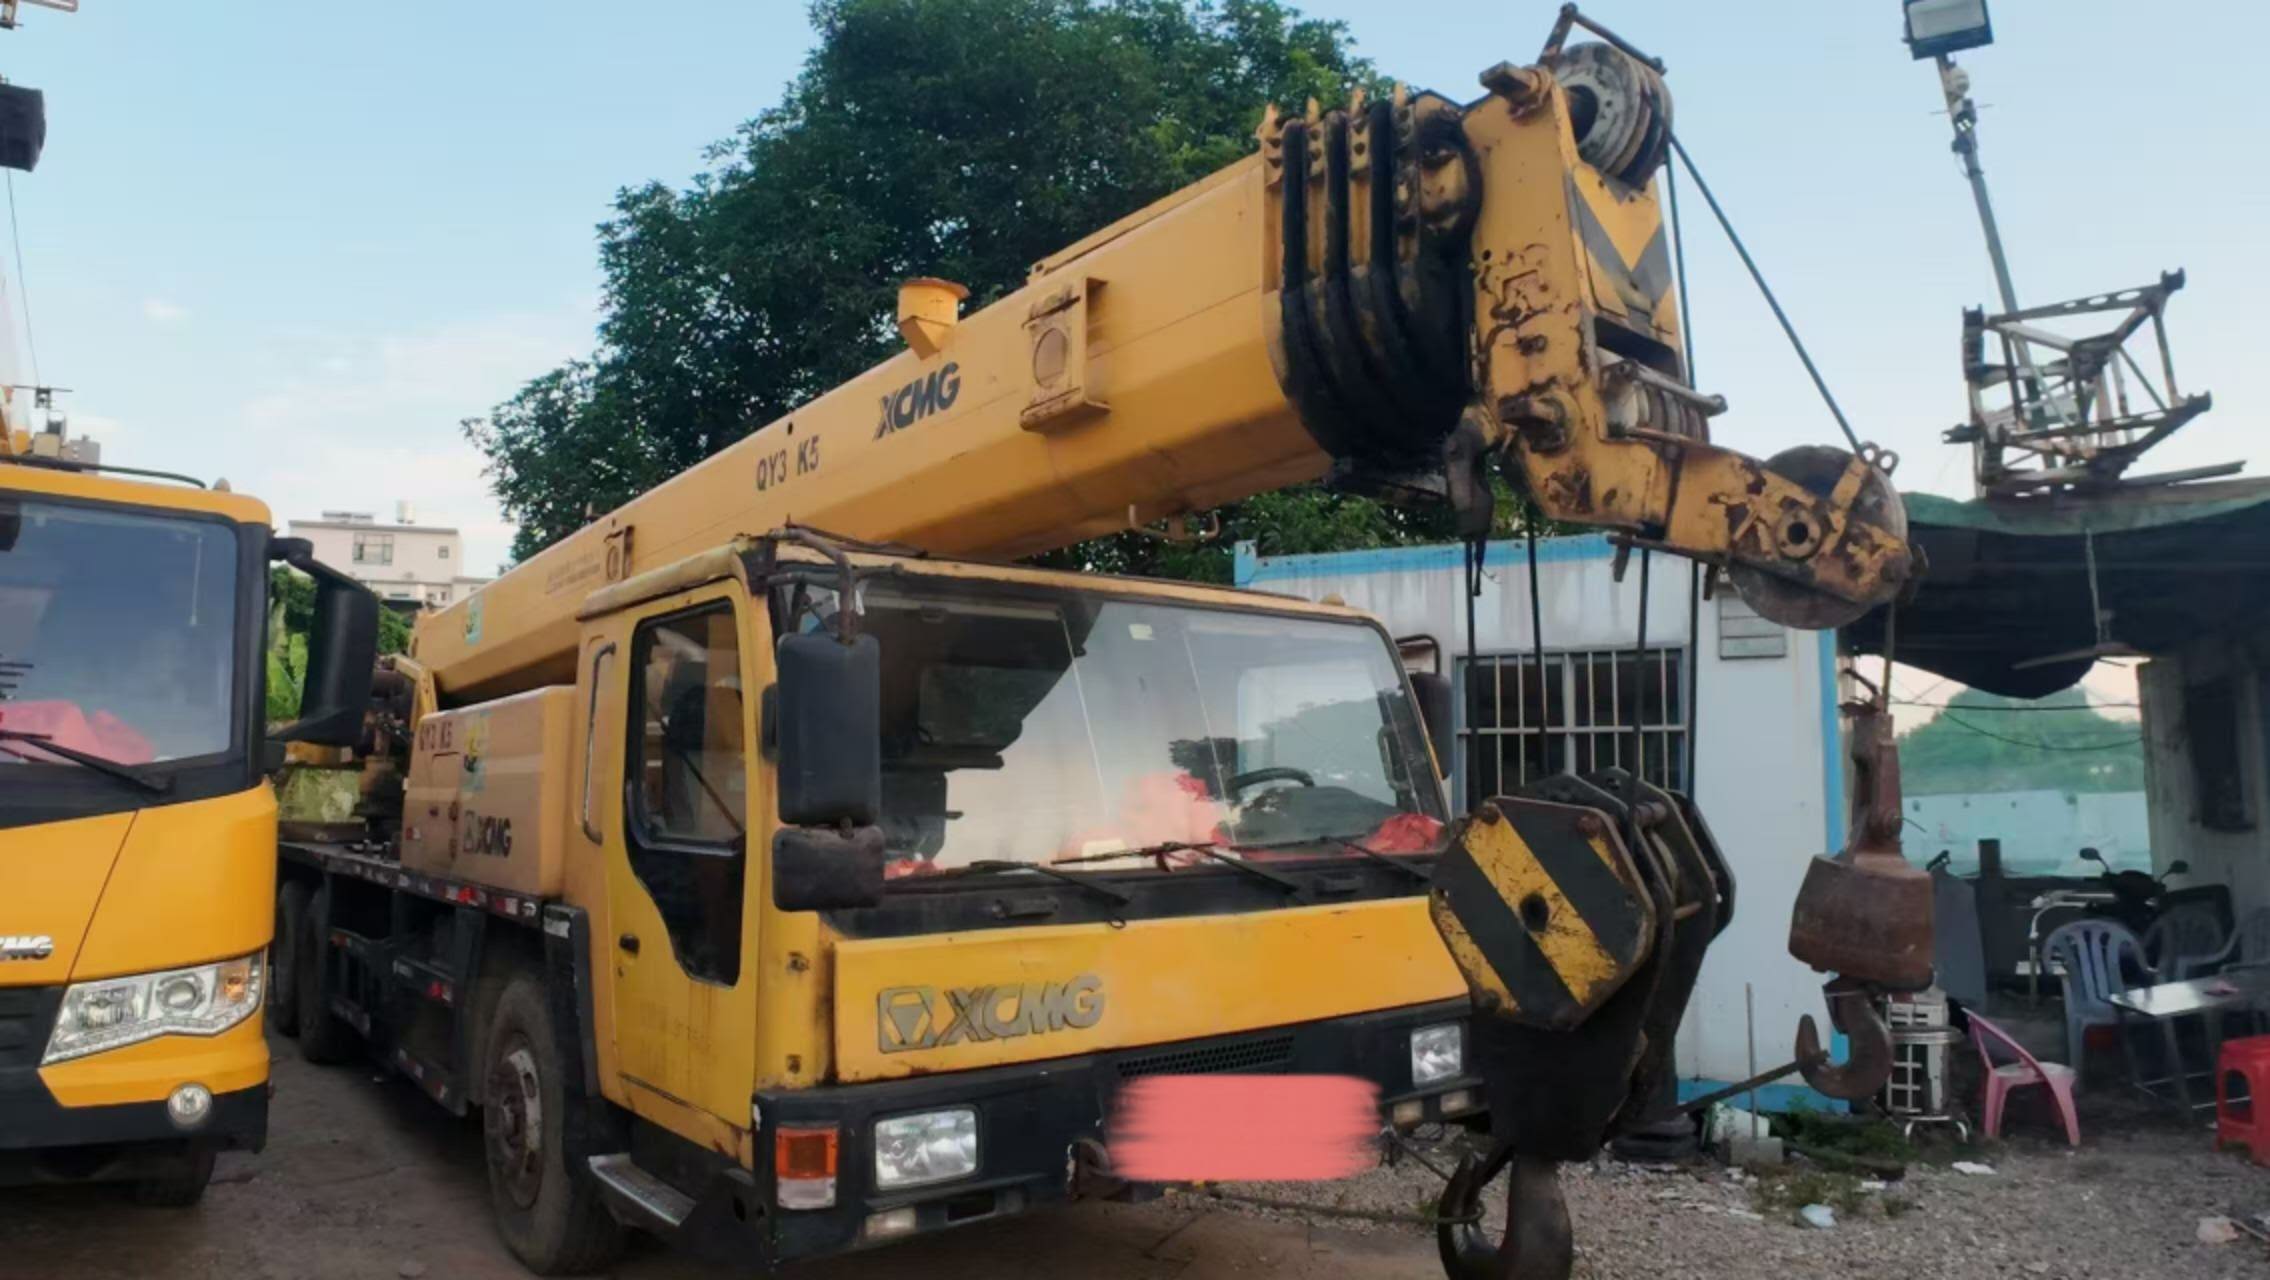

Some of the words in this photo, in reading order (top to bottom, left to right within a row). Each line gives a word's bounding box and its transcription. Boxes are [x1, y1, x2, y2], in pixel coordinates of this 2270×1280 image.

[872, 361, 961, 441] XCMG
[756, 448, 787, 491] QY3
[797, 435, 820, 476] K5
[477, 815, 513, 858] XCMG
[0, 935, 53, 960] MG
[934, 973, 1105, 1047] XCMG
